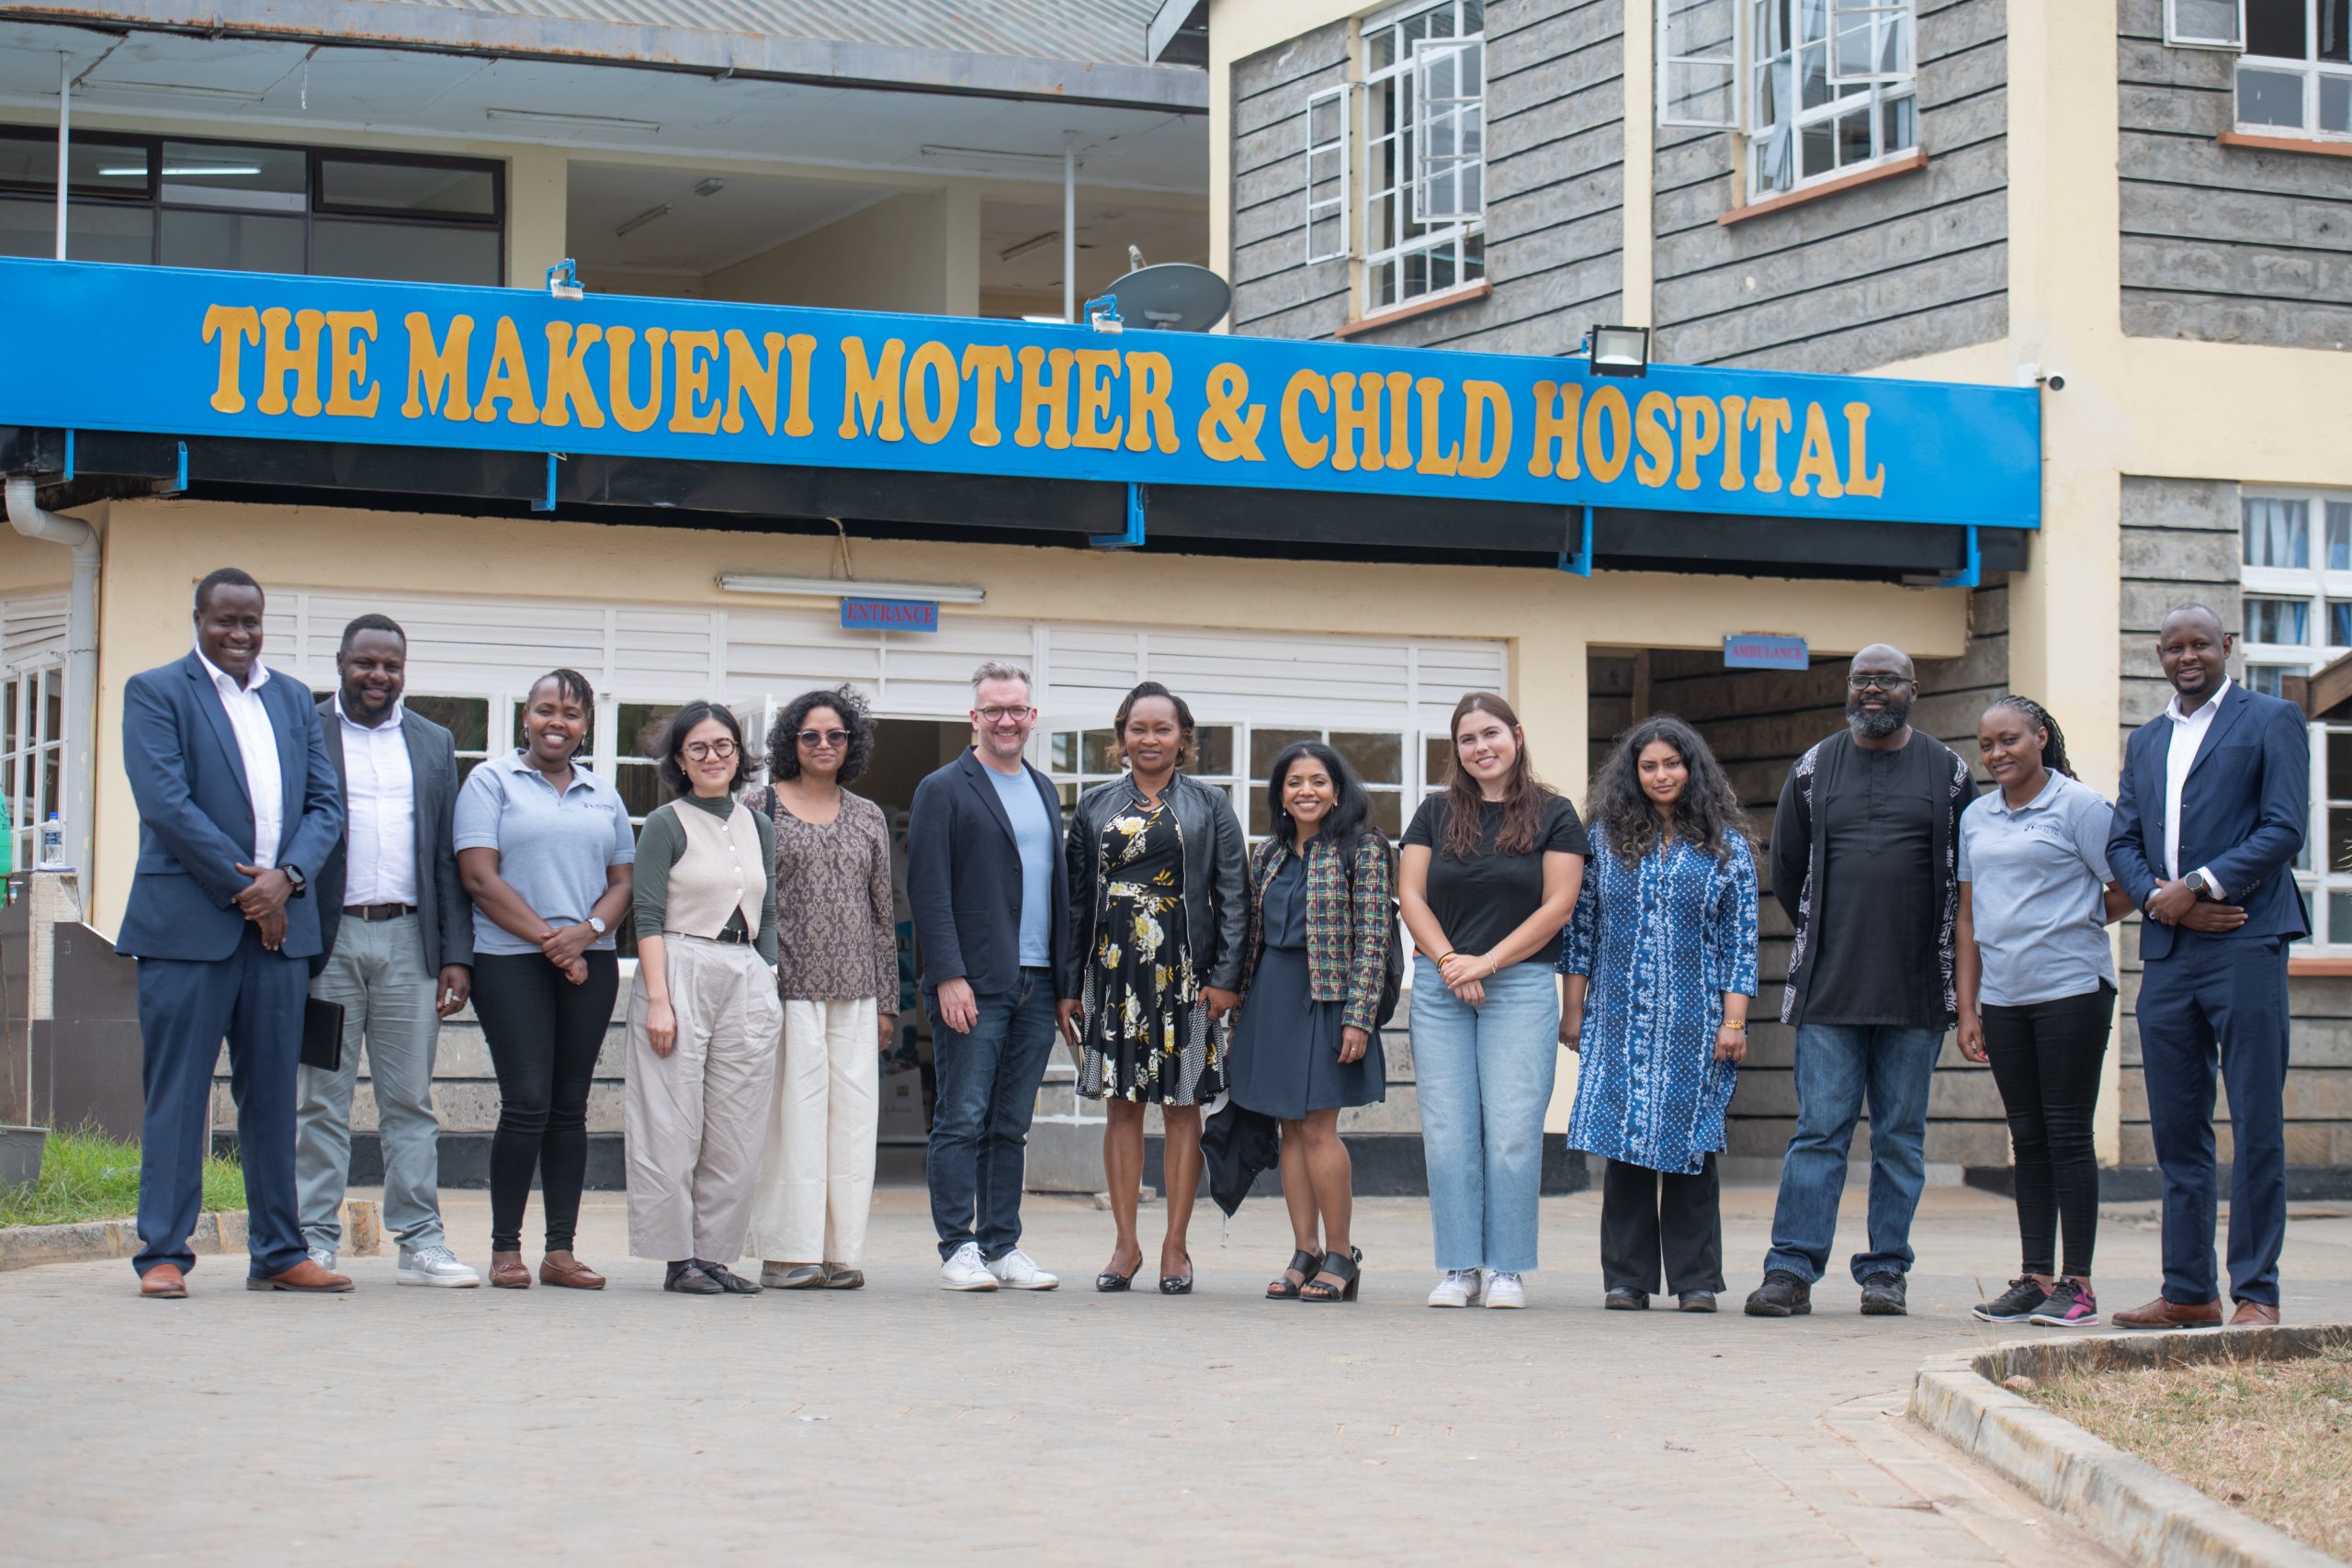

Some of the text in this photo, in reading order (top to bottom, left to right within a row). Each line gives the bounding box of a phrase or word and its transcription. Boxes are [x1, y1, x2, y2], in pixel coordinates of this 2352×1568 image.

[202, 303, 1885, 499] THE MAKUENI MOTHER & CHILD HOSPITAL
[846, 603, 934, 624] ENTRANCE
[1731, 646, 1803, 660] AMBULANCE
